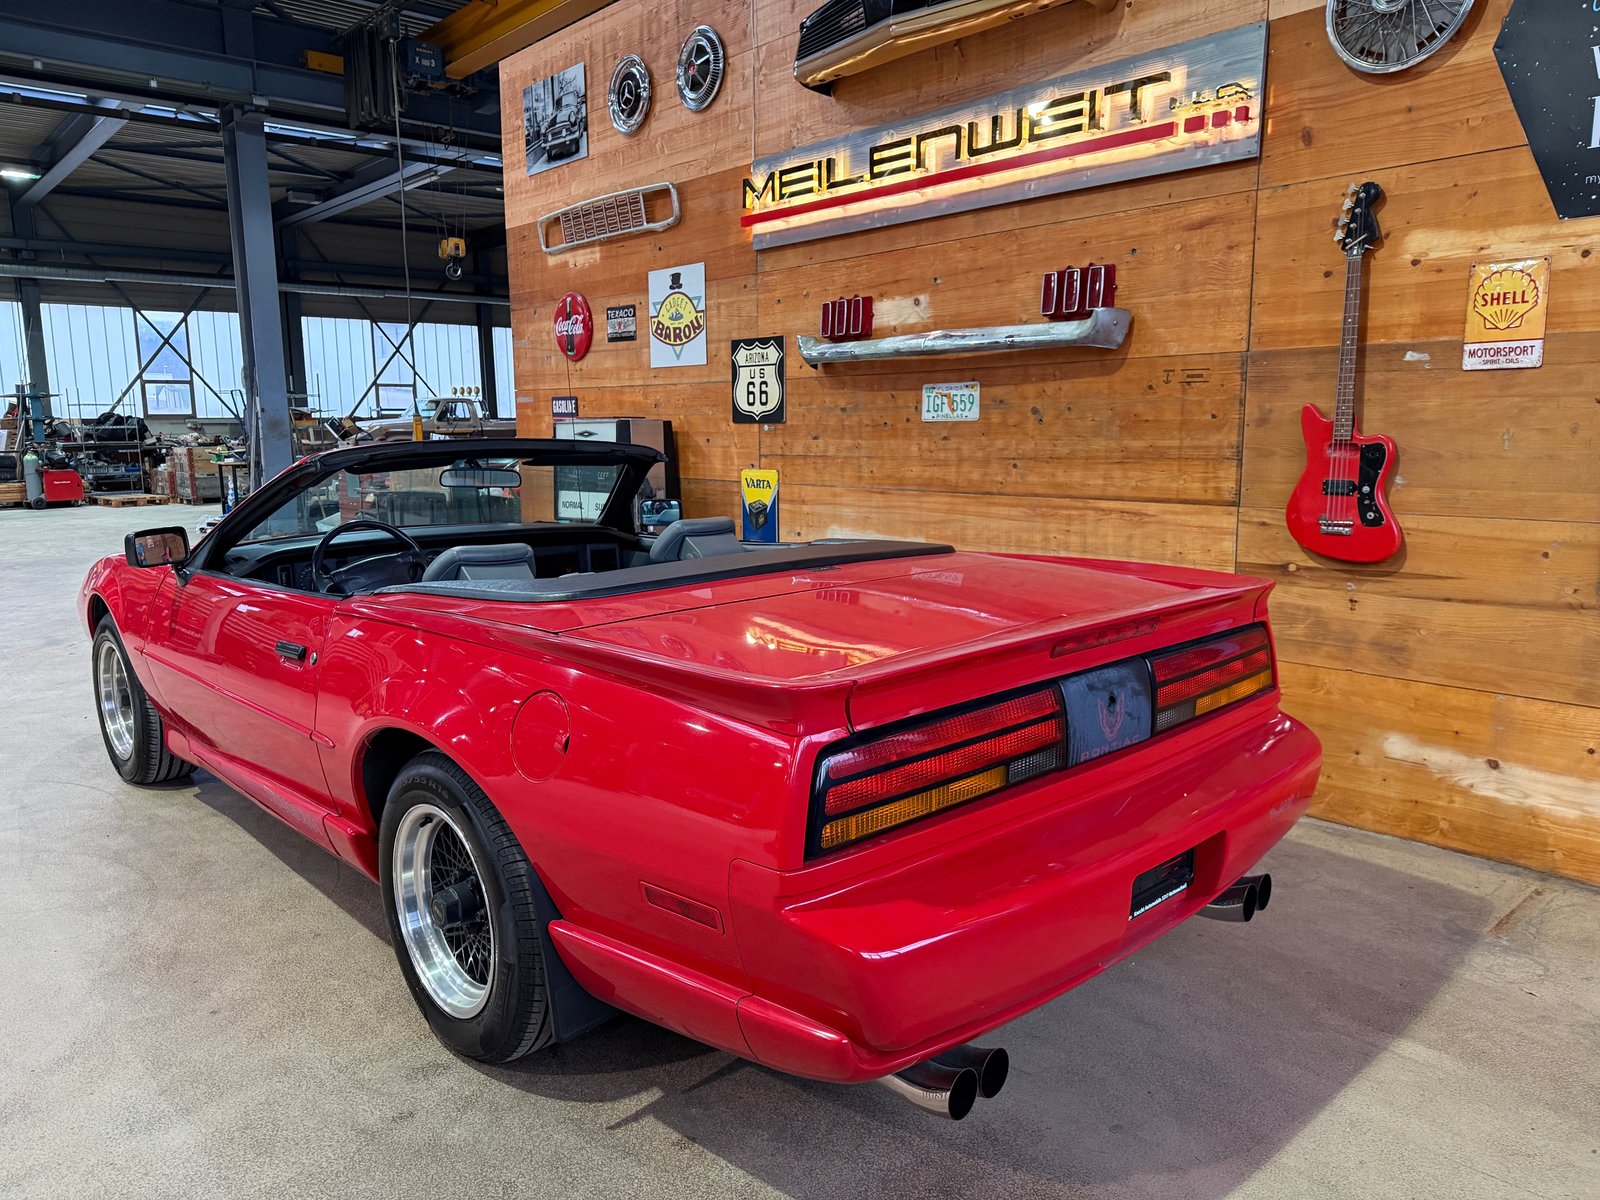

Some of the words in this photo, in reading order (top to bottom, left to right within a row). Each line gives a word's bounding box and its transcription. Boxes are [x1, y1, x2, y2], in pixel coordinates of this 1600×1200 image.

[1481, 289, 1530, 307] SHELL
[607, 308, 634, 319] TEXACO
[654, 315, 703, 342] BARON
[744, 351, 770, 364] ARIZONA
[1468, 345, 1536, 359] MOTORSPORT
[747, 380, 769, 407] 66
[552, 399, 576, 414] GASOLINE
[745, 477, 772, 490] VARTA
[561, 500, 584, 510] NORMAL
